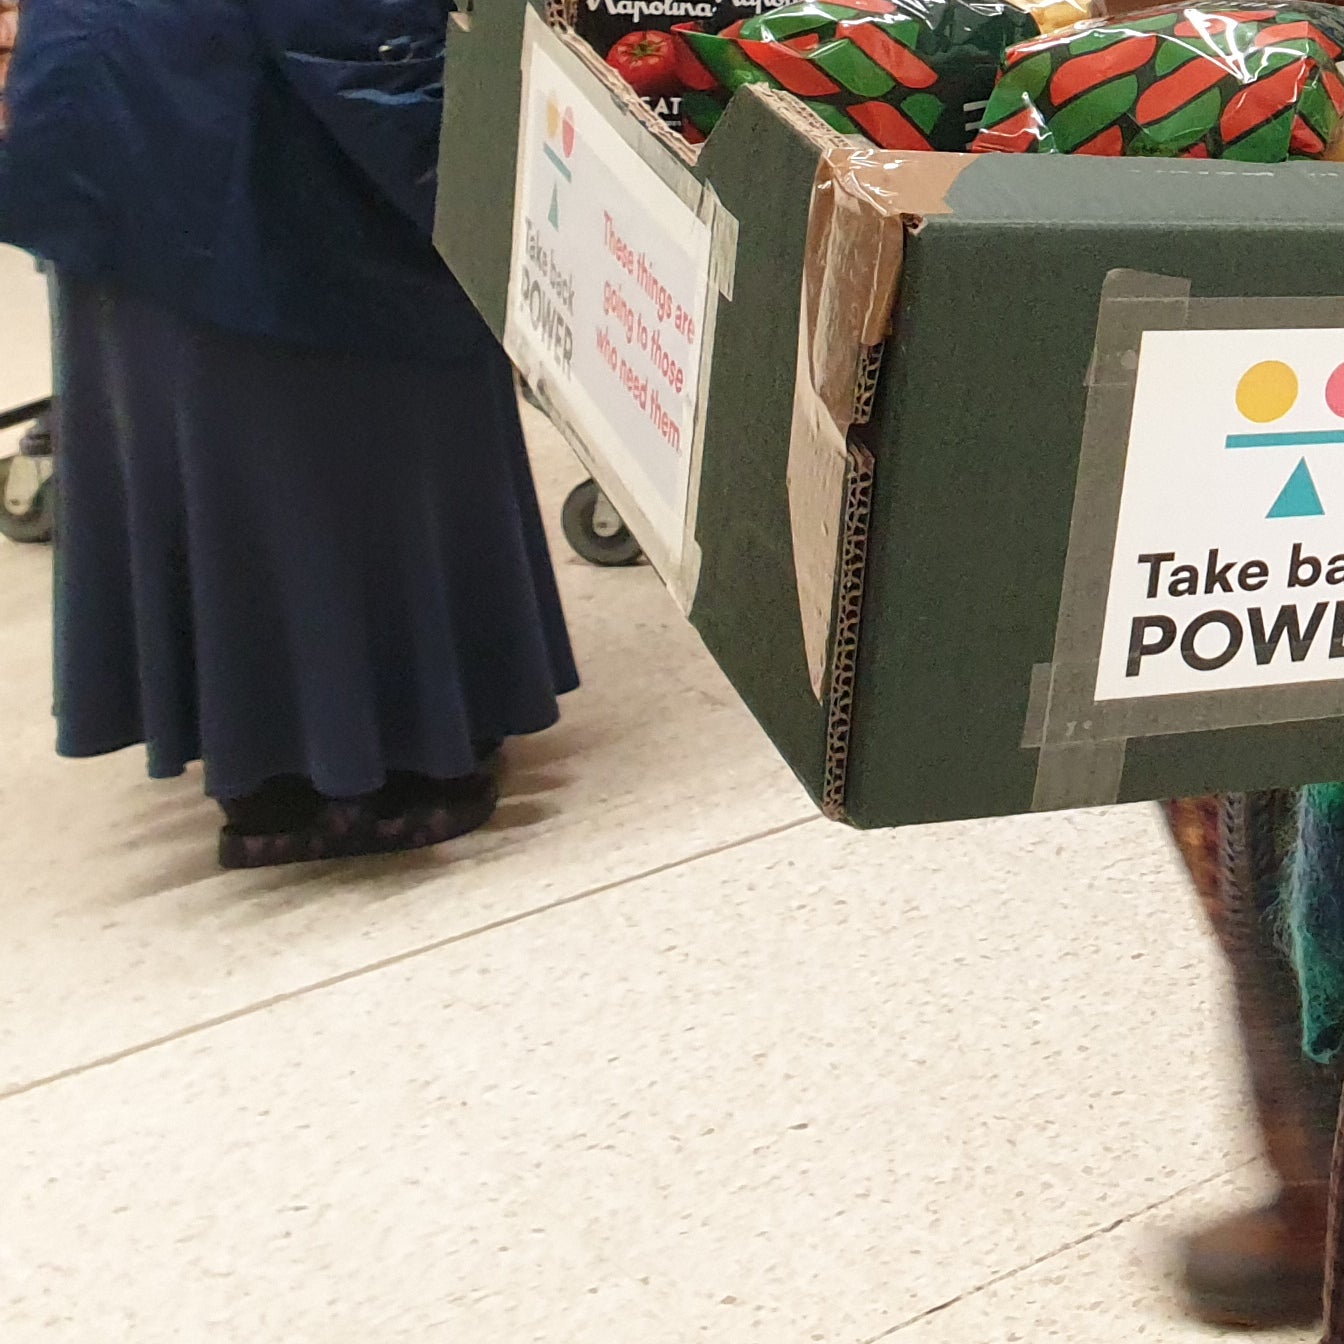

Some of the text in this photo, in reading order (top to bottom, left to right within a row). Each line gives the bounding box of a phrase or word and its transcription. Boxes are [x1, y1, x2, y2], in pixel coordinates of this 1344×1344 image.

[524, 216, 576, 305] Take back
[604, 210, 695, 345] These things are
[520, 264, 574, 381] POWER
[603, 280, 684, 394] going to those
[596, 324, 681, 452] who need them
[1139, 550, 1269, 601] Take
